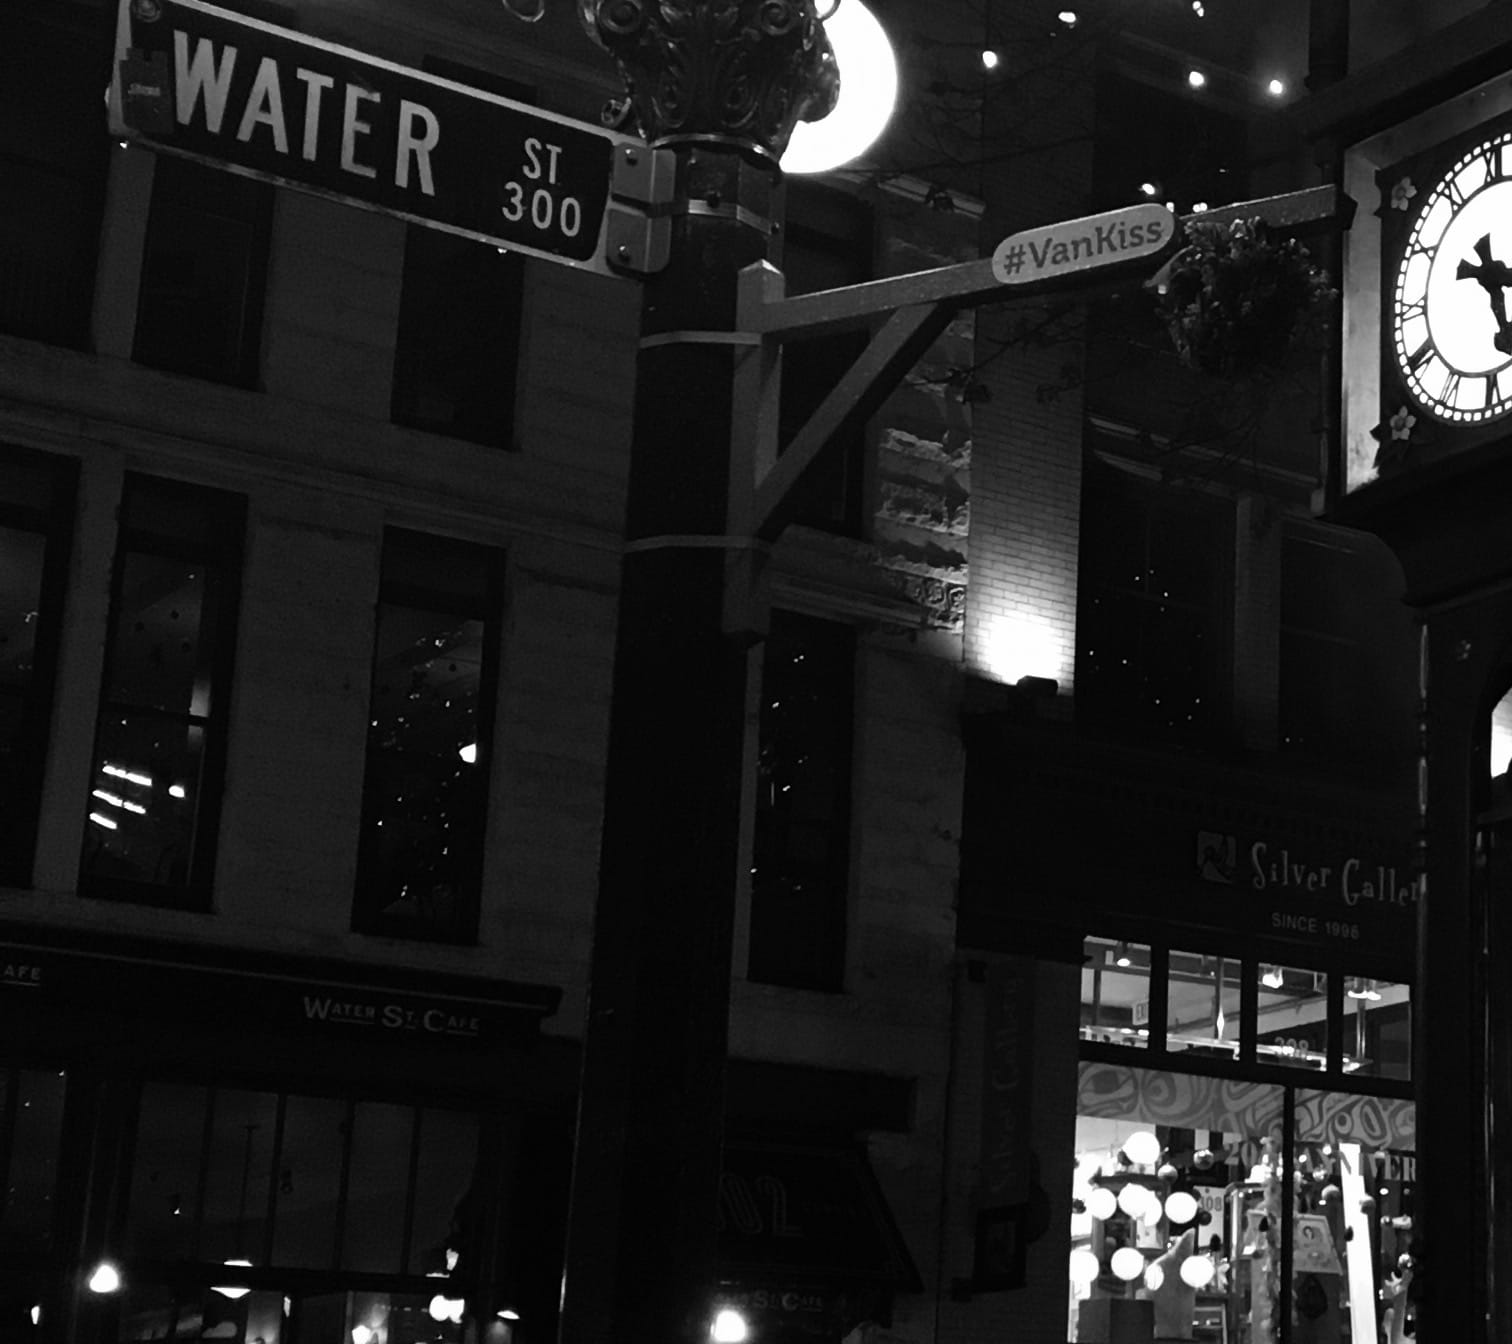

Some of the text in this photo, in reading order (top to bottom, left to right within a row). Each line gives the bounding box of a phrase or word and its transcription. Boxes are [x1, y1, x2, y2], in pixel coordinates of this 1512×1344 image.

[173, 29, 563, 197] WATER ST
[502, 180, 582, 238] 300
[1003, 220, 1162, 275] #VanKiss
[1250, 841, 1420, 907] Silver Galler
[1271, 911, 1318, 934] SINCE
[2, 964, 41, 982] AFE
[303, 995, 376, 1019] WATER
[423, 1008, 481, 1033] CAFE
